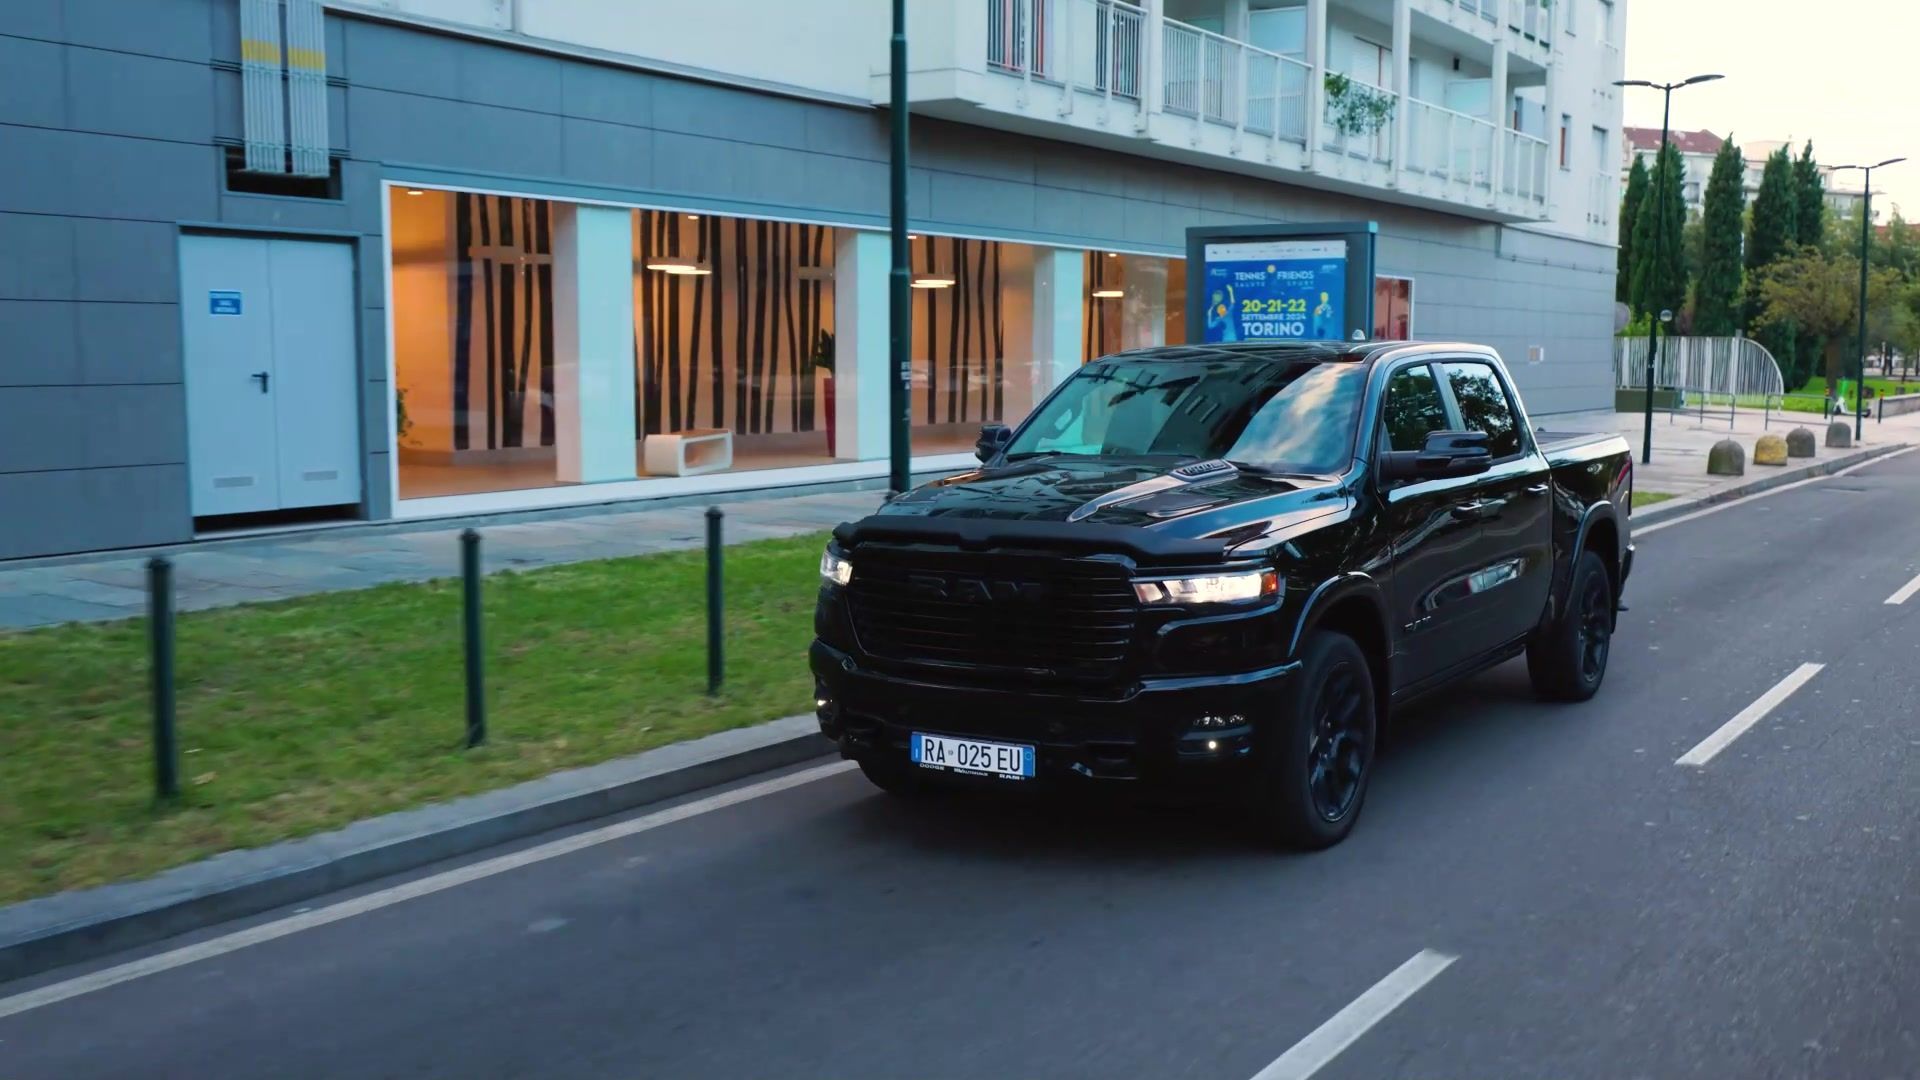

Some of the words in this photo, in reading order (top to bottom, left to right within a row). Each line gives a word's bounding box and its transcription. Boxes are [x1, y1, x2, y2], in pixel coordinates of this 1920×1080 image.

[1234, 271, 1265, 281] TENNIS
[1277, 270, 1314, 280] FRIENDS
[1241, 299, 1306, 313] 20-21-22
[1241, 313, 1284, 321] SETTEMBRE
[1286, 312, 1306, 320] 2024
[1242, 322, 1304, 336] TORINO
[924, 738, 946, 763] RA
[957, 743, 992, 769] 025
[997, 747, 1020, 772] EU
[919, 763, 945, 771] DODGE
